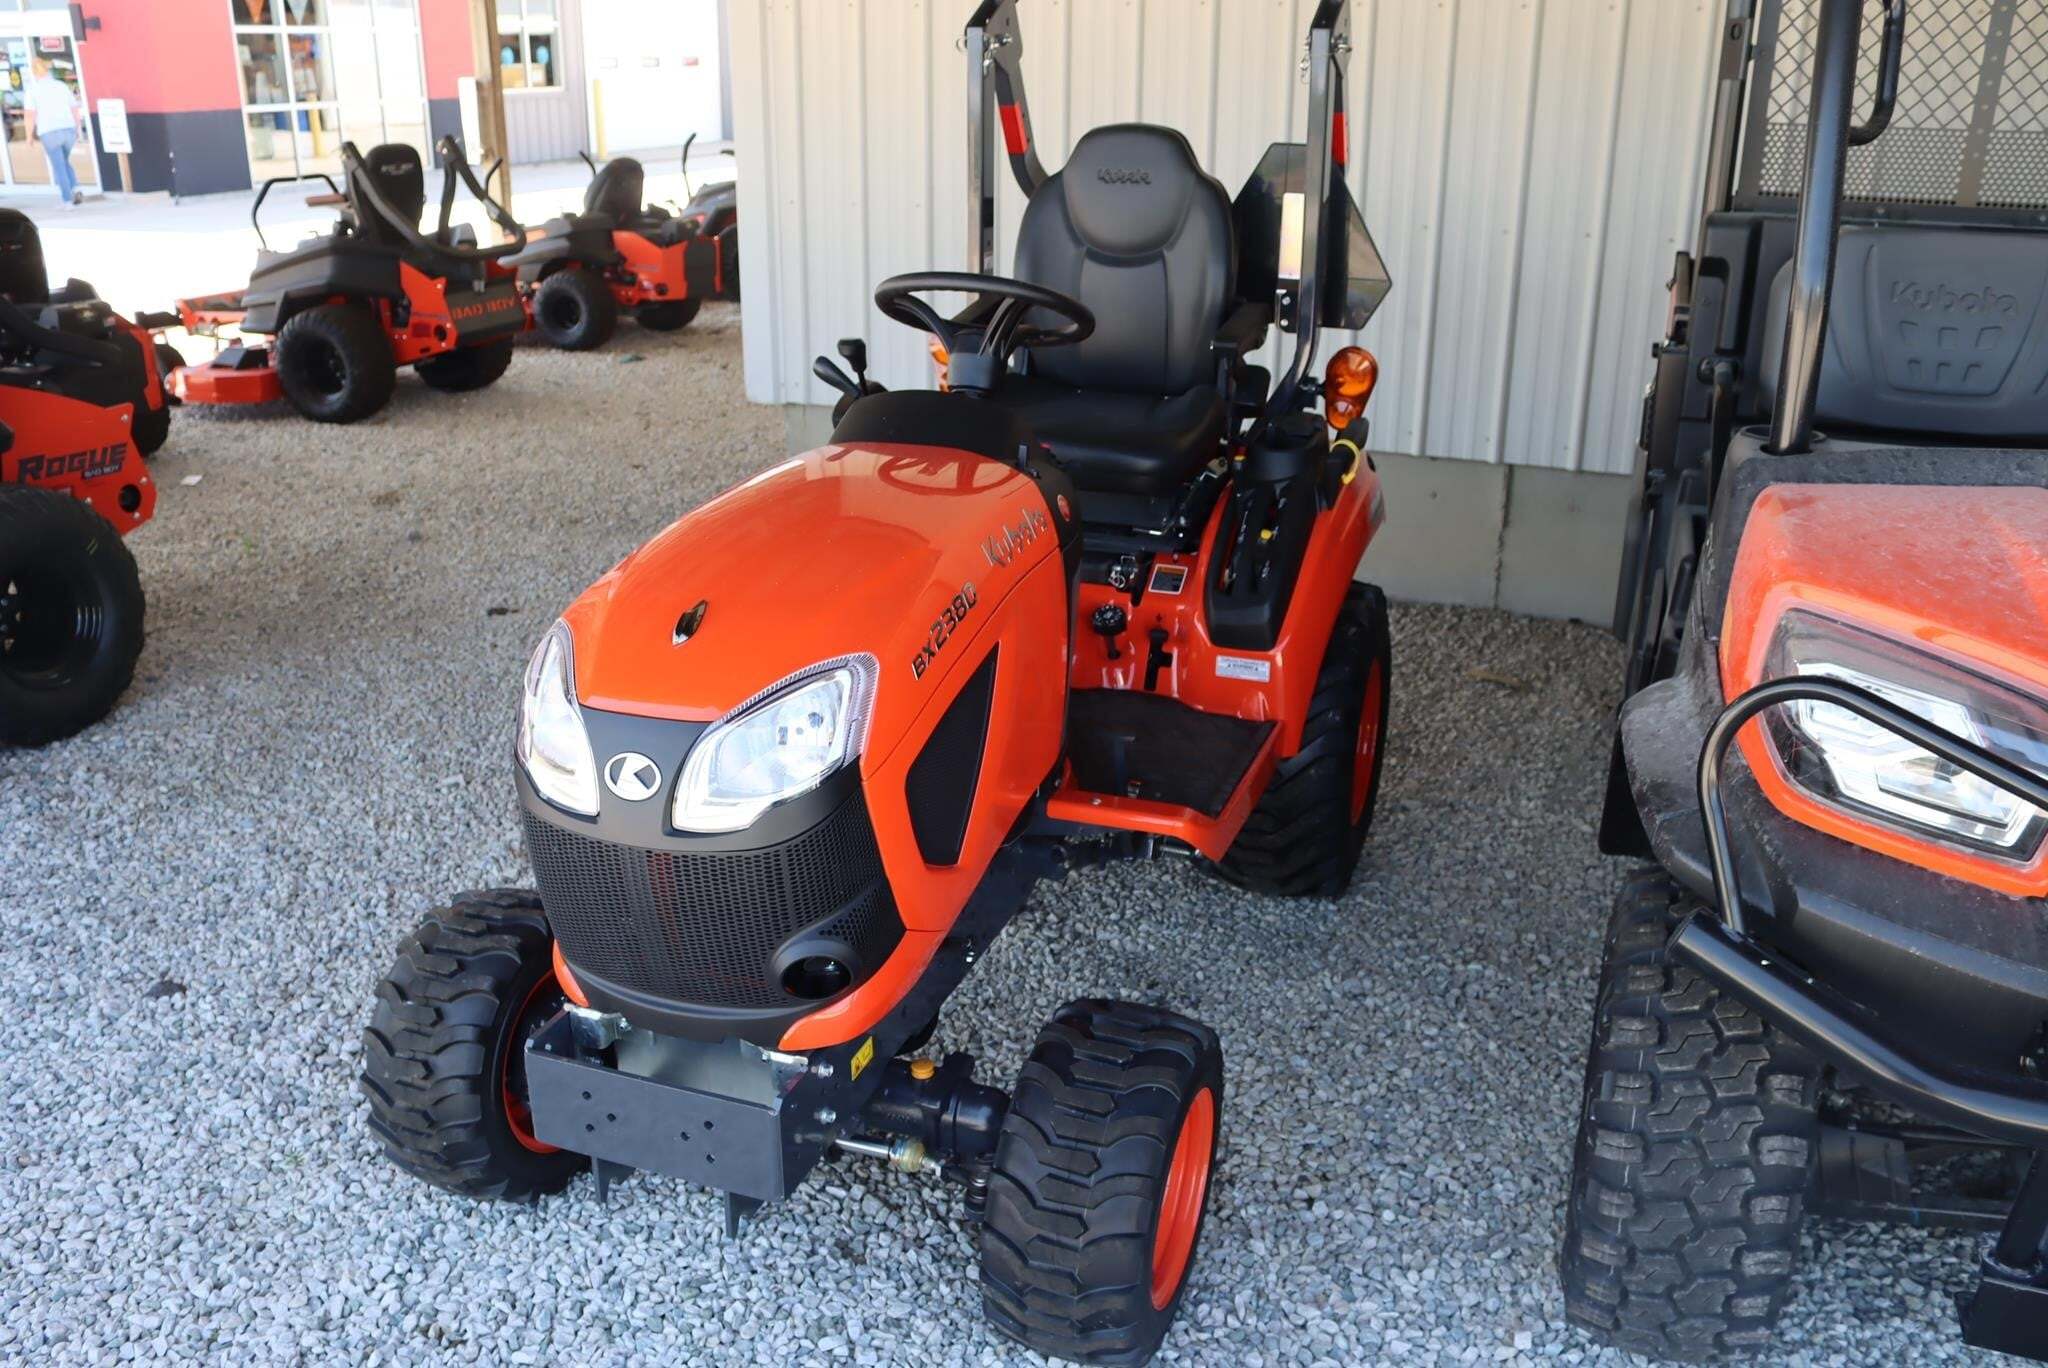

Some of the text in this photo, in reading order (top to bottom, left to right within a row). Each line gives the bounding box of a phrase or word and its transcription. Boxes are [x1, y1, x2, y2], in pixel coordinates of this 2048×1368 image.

[1889, 280, 2018, 313] Kubota
[18, 442, 128, 484] ROGUE
[980, 508, 1049, 568] Kubota
[911, 581, 977, 681] BX2380
